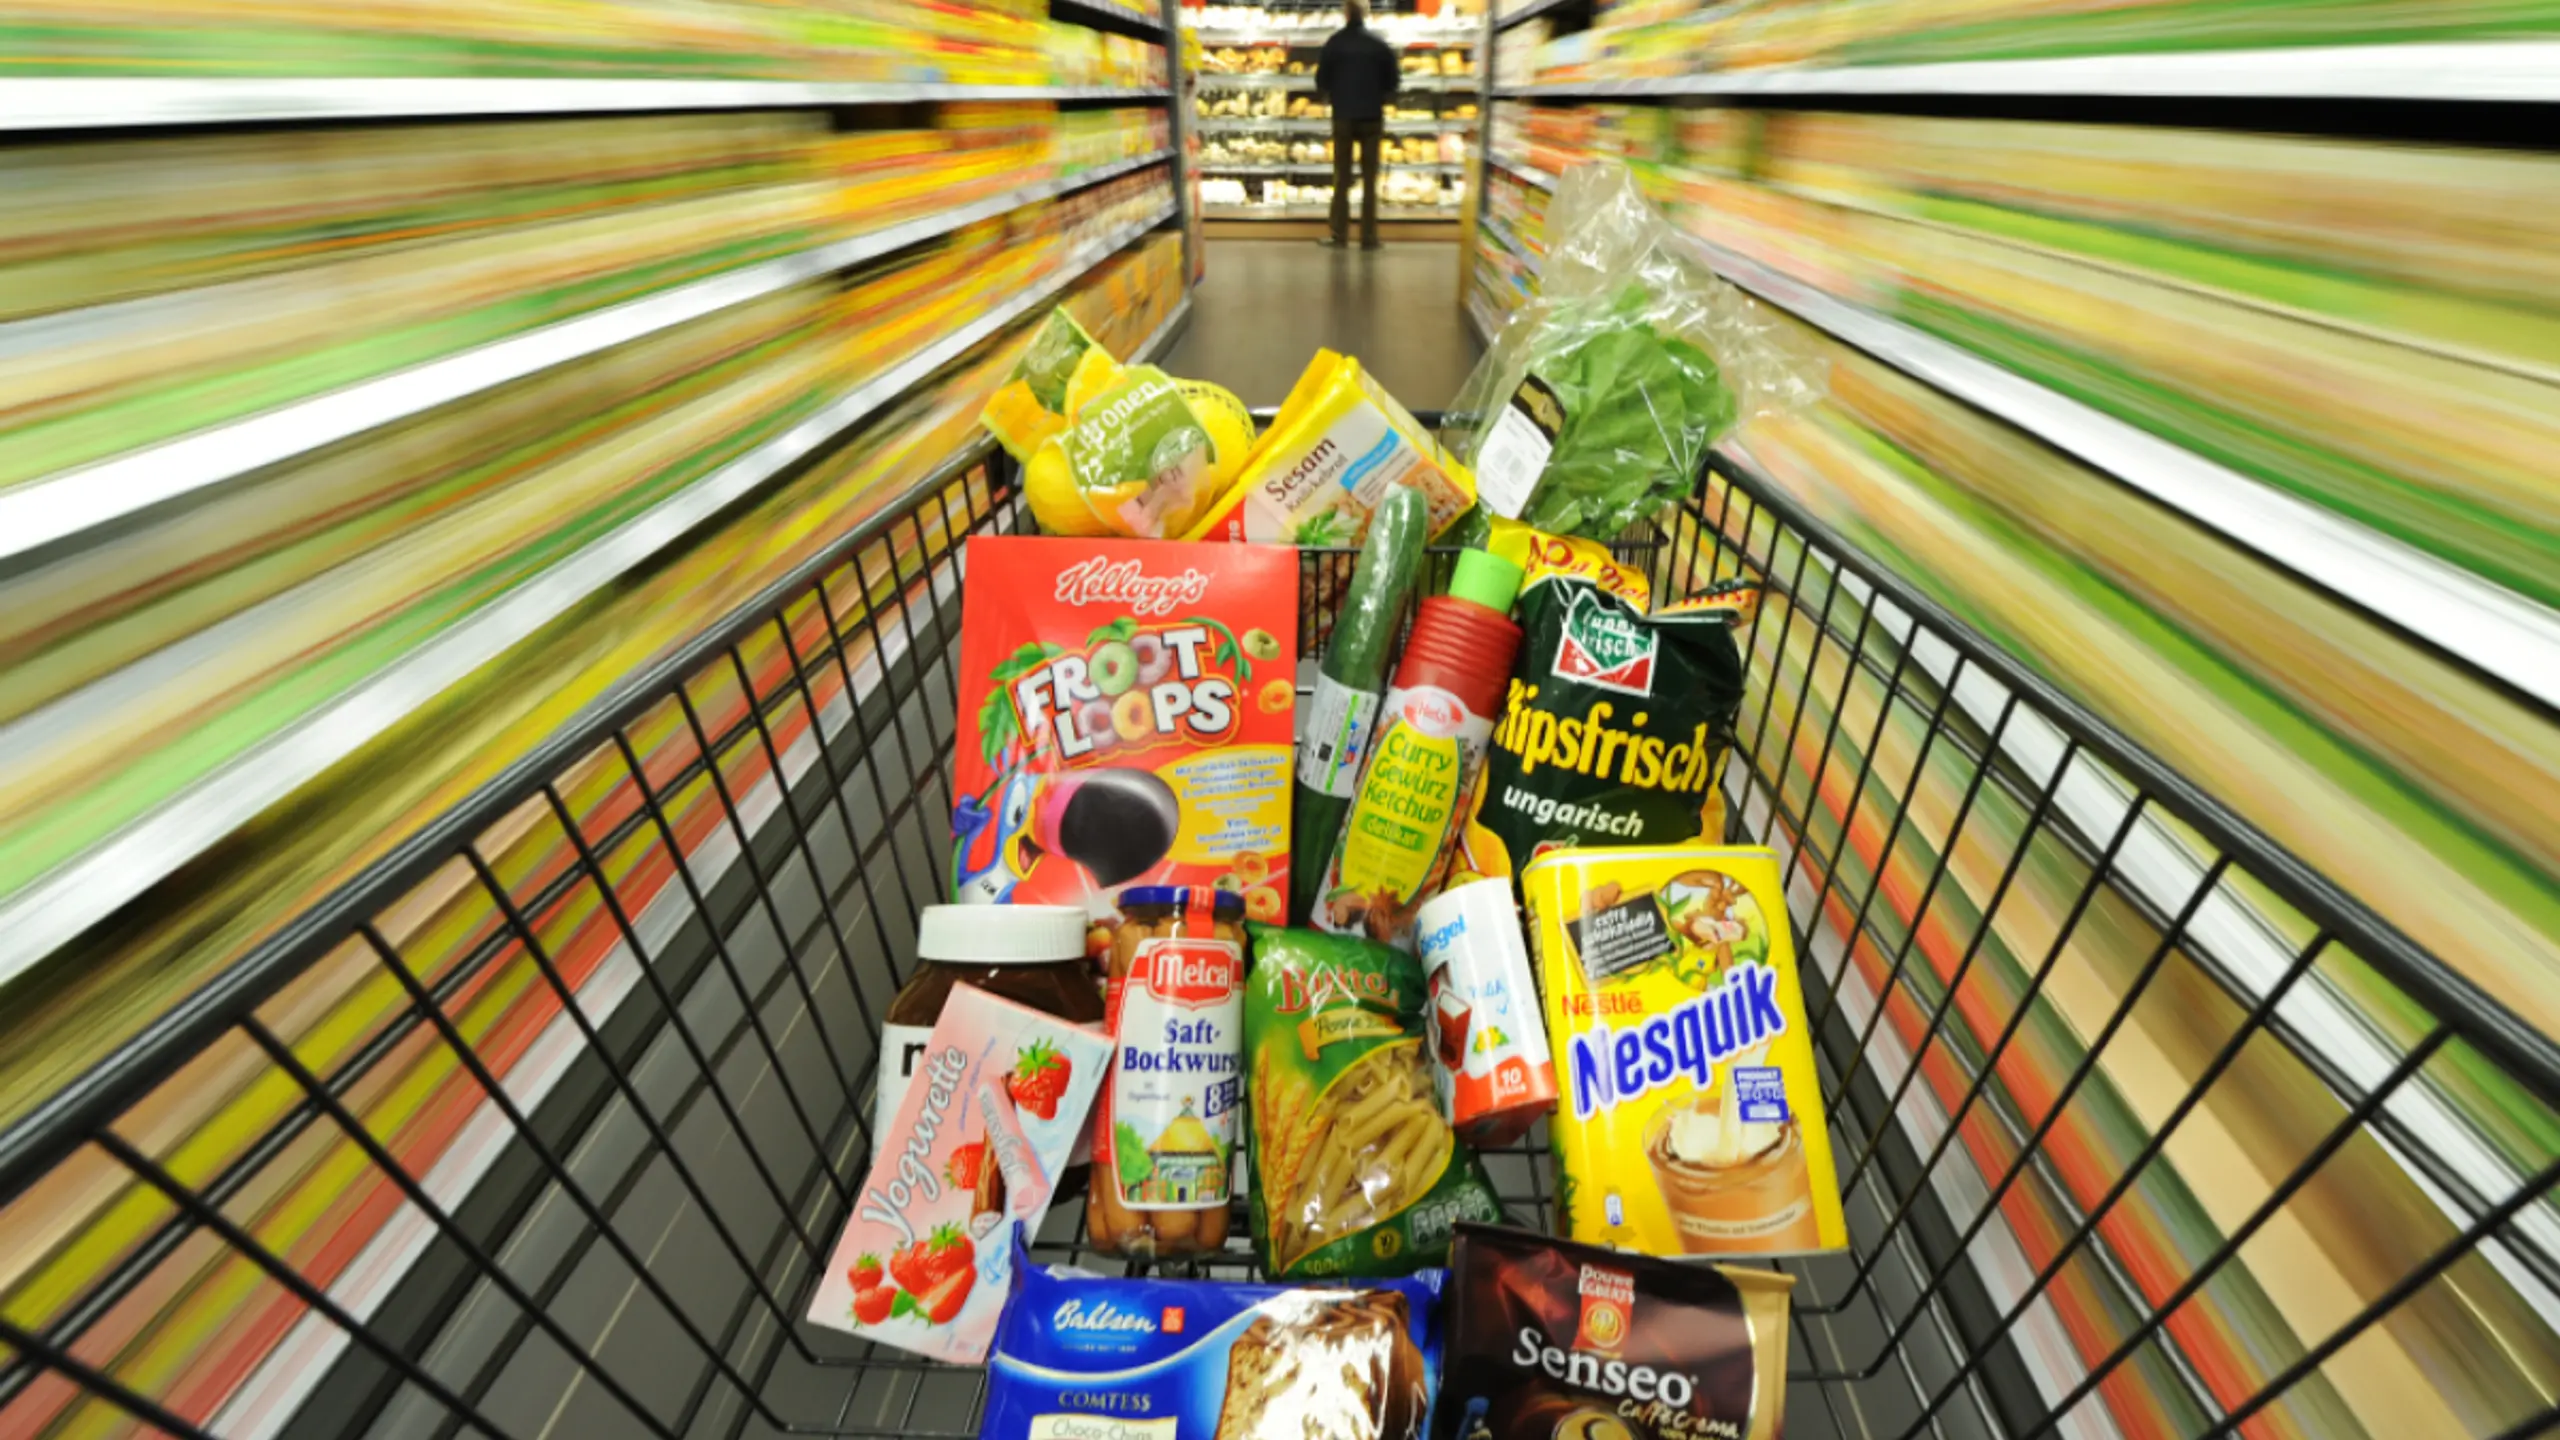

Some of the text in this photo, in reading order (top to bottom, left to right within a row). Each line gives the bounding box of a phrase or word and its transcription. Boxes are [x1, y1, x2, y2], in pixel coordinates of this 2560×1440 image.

[1265, 438, 1337, 502] Sesam
[1055, 555, 1209, 616] Kellogg's
[1017, 627, 1207, 732] FROOT
[1053, 678, 1232, 760] LOOPS
[1388, 732, 1452, 772] Curry
[1374, 756, 1450, 801] Gewürz
[1366, 779, 1445, 824] Ketchup
[1503, 785, 1644, 838] ungarisch
[1561, 989, 1643, 1017] Nestlé
[1163, 1017, 1221, 1045] Saft-
[1571, 965, 1784, 1116] Nesquik
[1208, 1083, 1221, 1115] 8
[1501, 1066, 1521, 1087] 10
[862, 1044, 967, 1249] Yogurette
[1054, 1299, 1157, 1334] Bahlsen
[1512, 1326, 1692, 1408] Senseo
[1058, 1390, 1152, 1413] COMTESS
